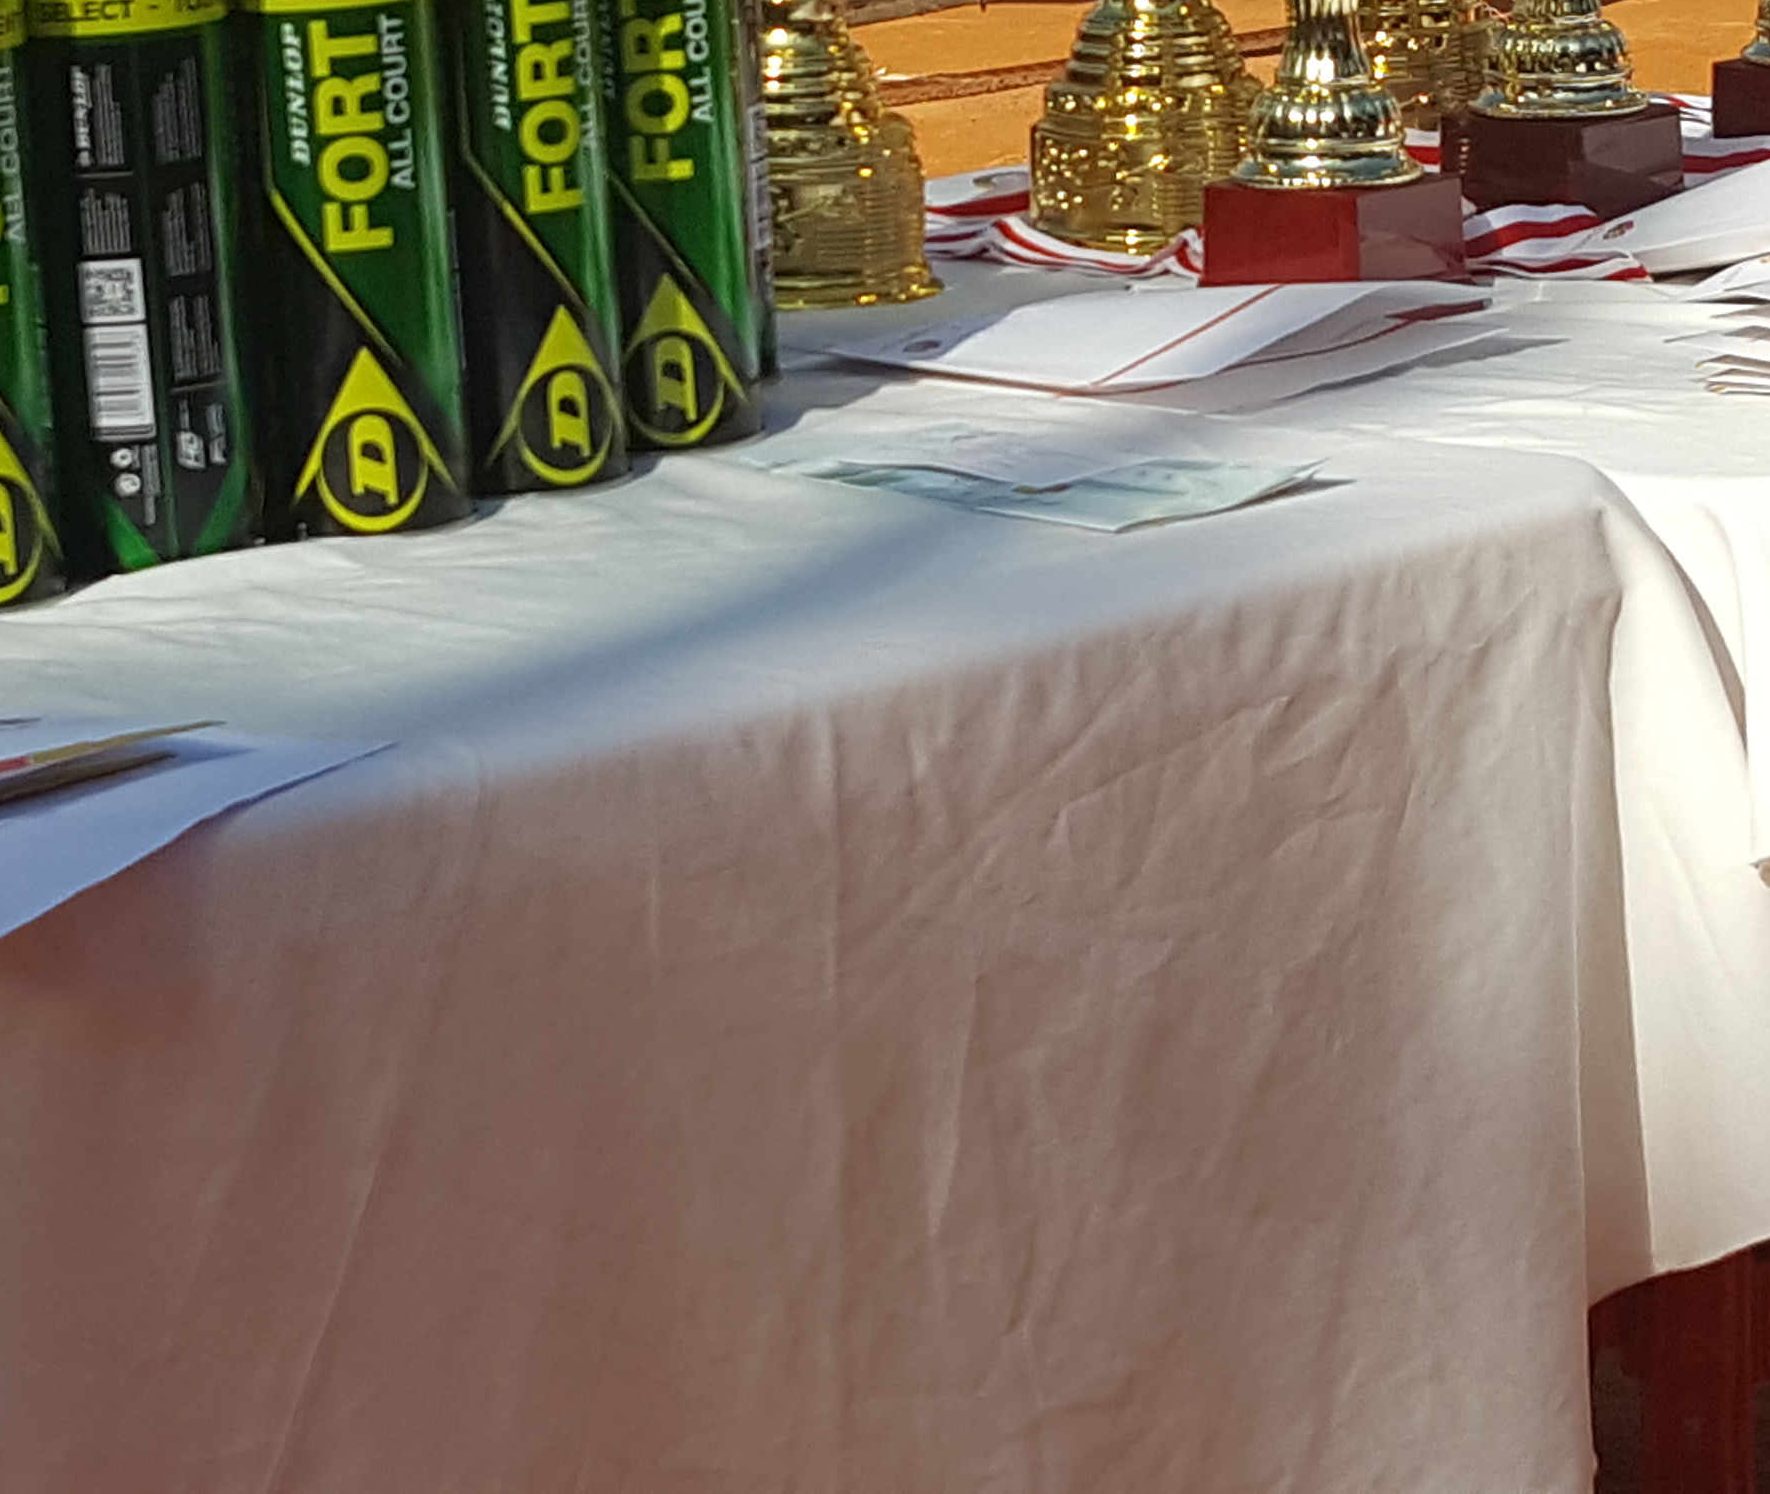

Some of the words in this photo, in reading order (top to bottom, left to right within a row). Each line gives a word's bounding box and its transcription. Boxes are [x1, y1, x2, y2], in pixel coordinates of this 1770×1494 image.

[280, 22, 312, 168] DUNLOP
[378, 13, 410, 125] COURT
[690, 66, 717, 125] ALL
[306, 19, 395, 254] FORT
[389, 128, 417, 191] ALL
